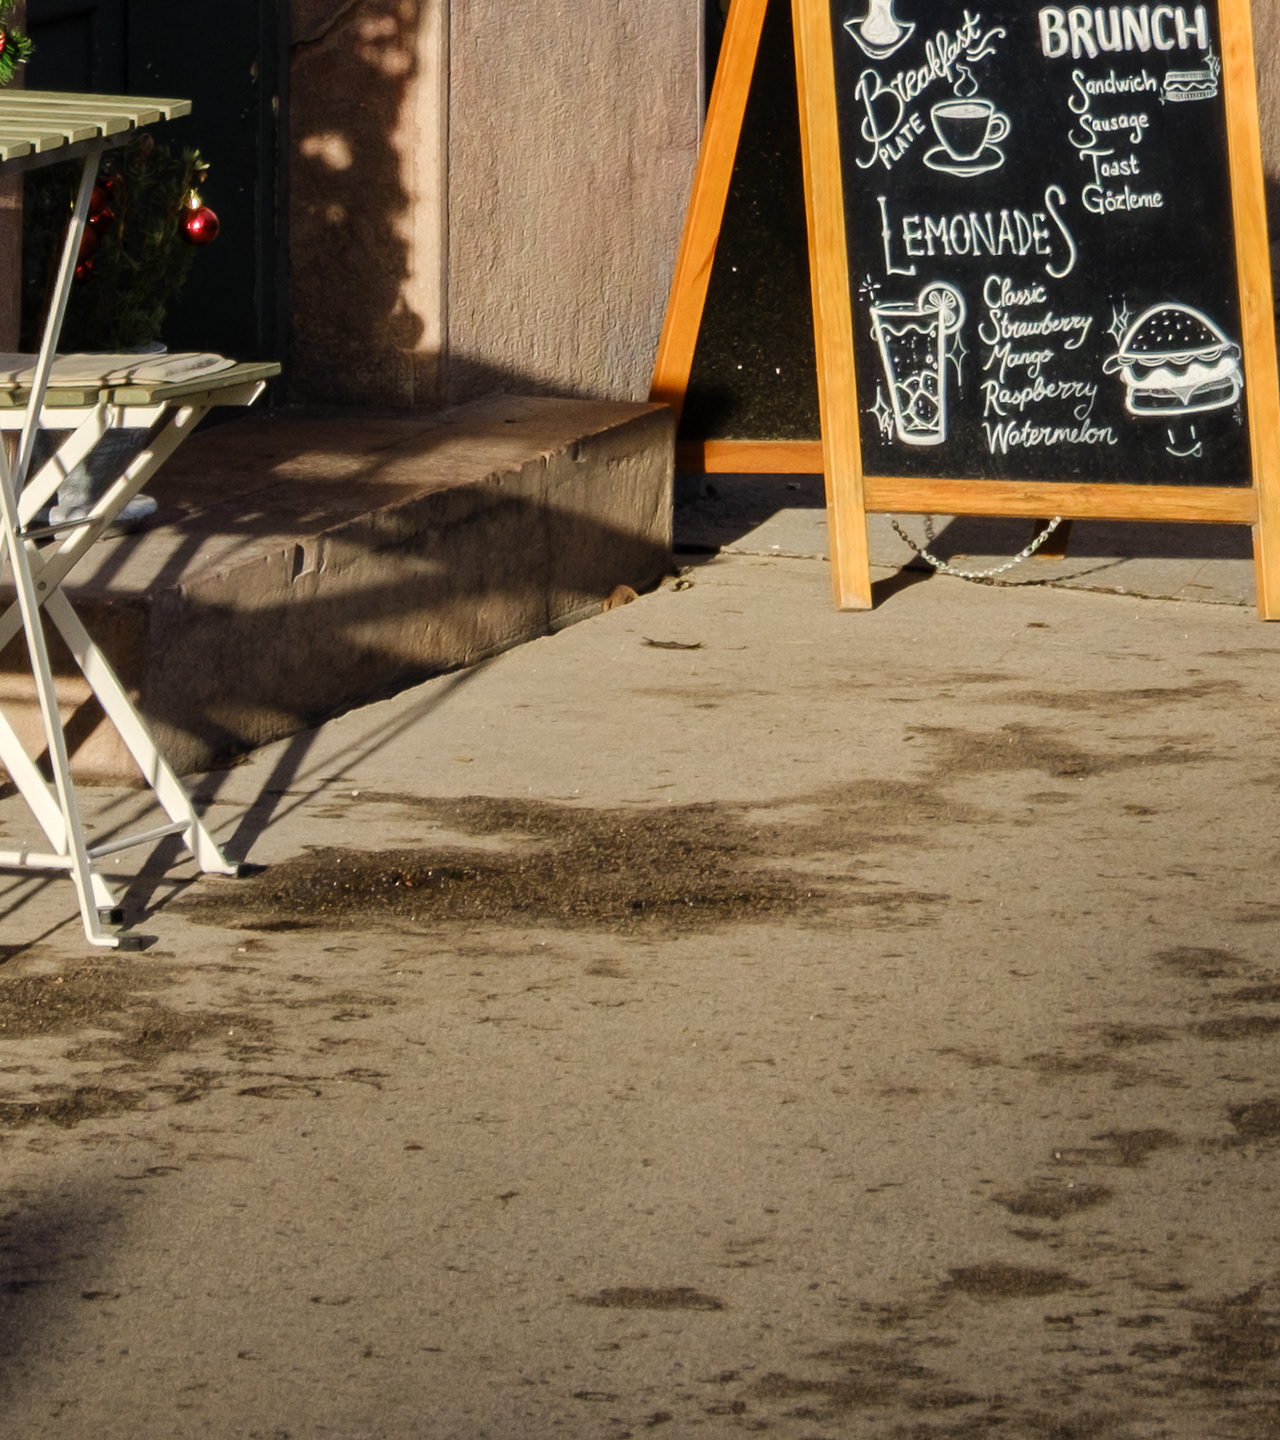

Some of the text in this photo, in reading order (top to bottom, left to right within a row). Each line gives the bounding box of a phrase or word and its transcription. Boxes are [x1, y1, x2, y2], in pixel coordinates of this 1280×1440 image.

[1038, 4, 1209, 60] BRUNCH
[855, 8, 981, 170] Breakfast
[1067, 67, 1157, 115] Sandwich
[878, 112, 927, 171] PLATE
[1067, 113, 1150, 149] Sausage
[1078, 147, 1140, 186] Toast
[1081, 182, 1164, 215] Gözleme
[983, 273, 1047, 309] Classic
[977, 308, 1093, 351] Strawberry
[982, 341, 1055, 384] Mango
[979, 377, 1098, 421] Raspberry
[981, 418, 1118, 455] Watermelon
